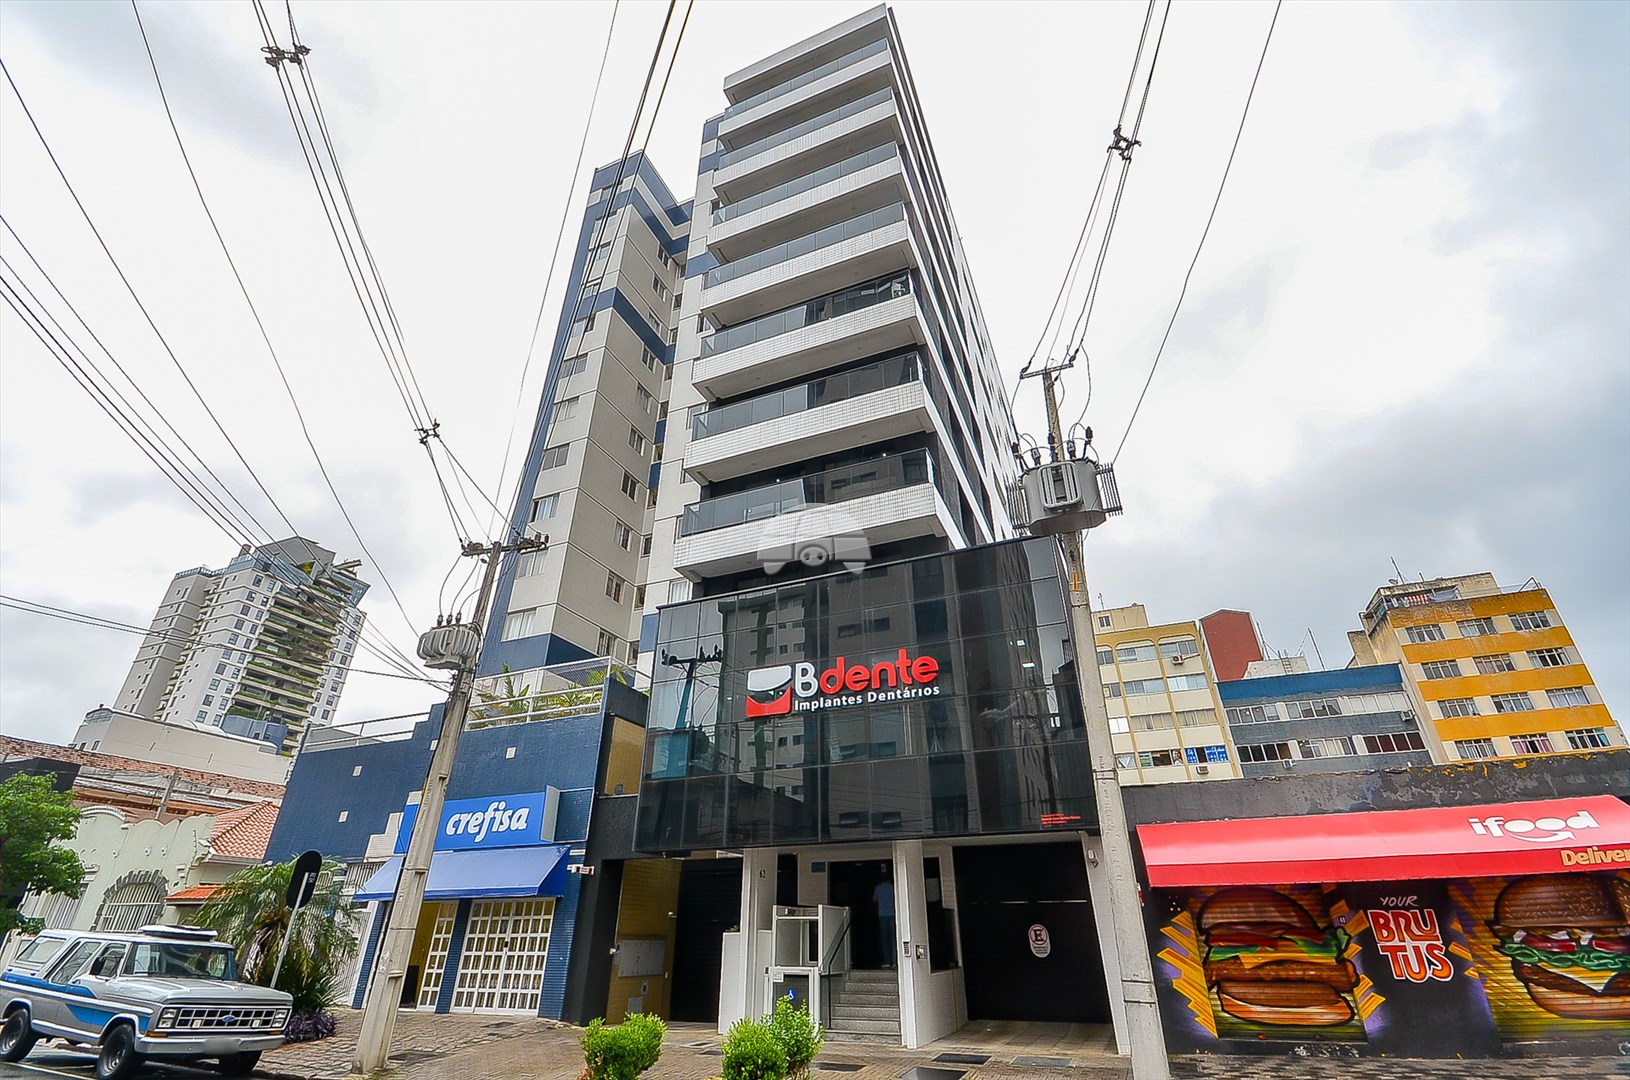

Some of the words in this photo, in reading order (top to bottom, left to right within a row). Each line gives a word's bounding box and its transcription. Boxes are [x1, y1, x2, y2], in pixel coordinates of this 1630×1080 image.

[795, 648, 939, 698] Bdente
[795, 695, 863, 712] Implantes
[867, 685, 941, 704] Dentários
[446, 801, 530, 843] crefisa
[1468, 810, 1601, 838] ifood
[1380, 895, 1419, 907] YOUR
[1367, 909, 1443, 943] BRU
[1377, 942, 1454, 983] TUS
